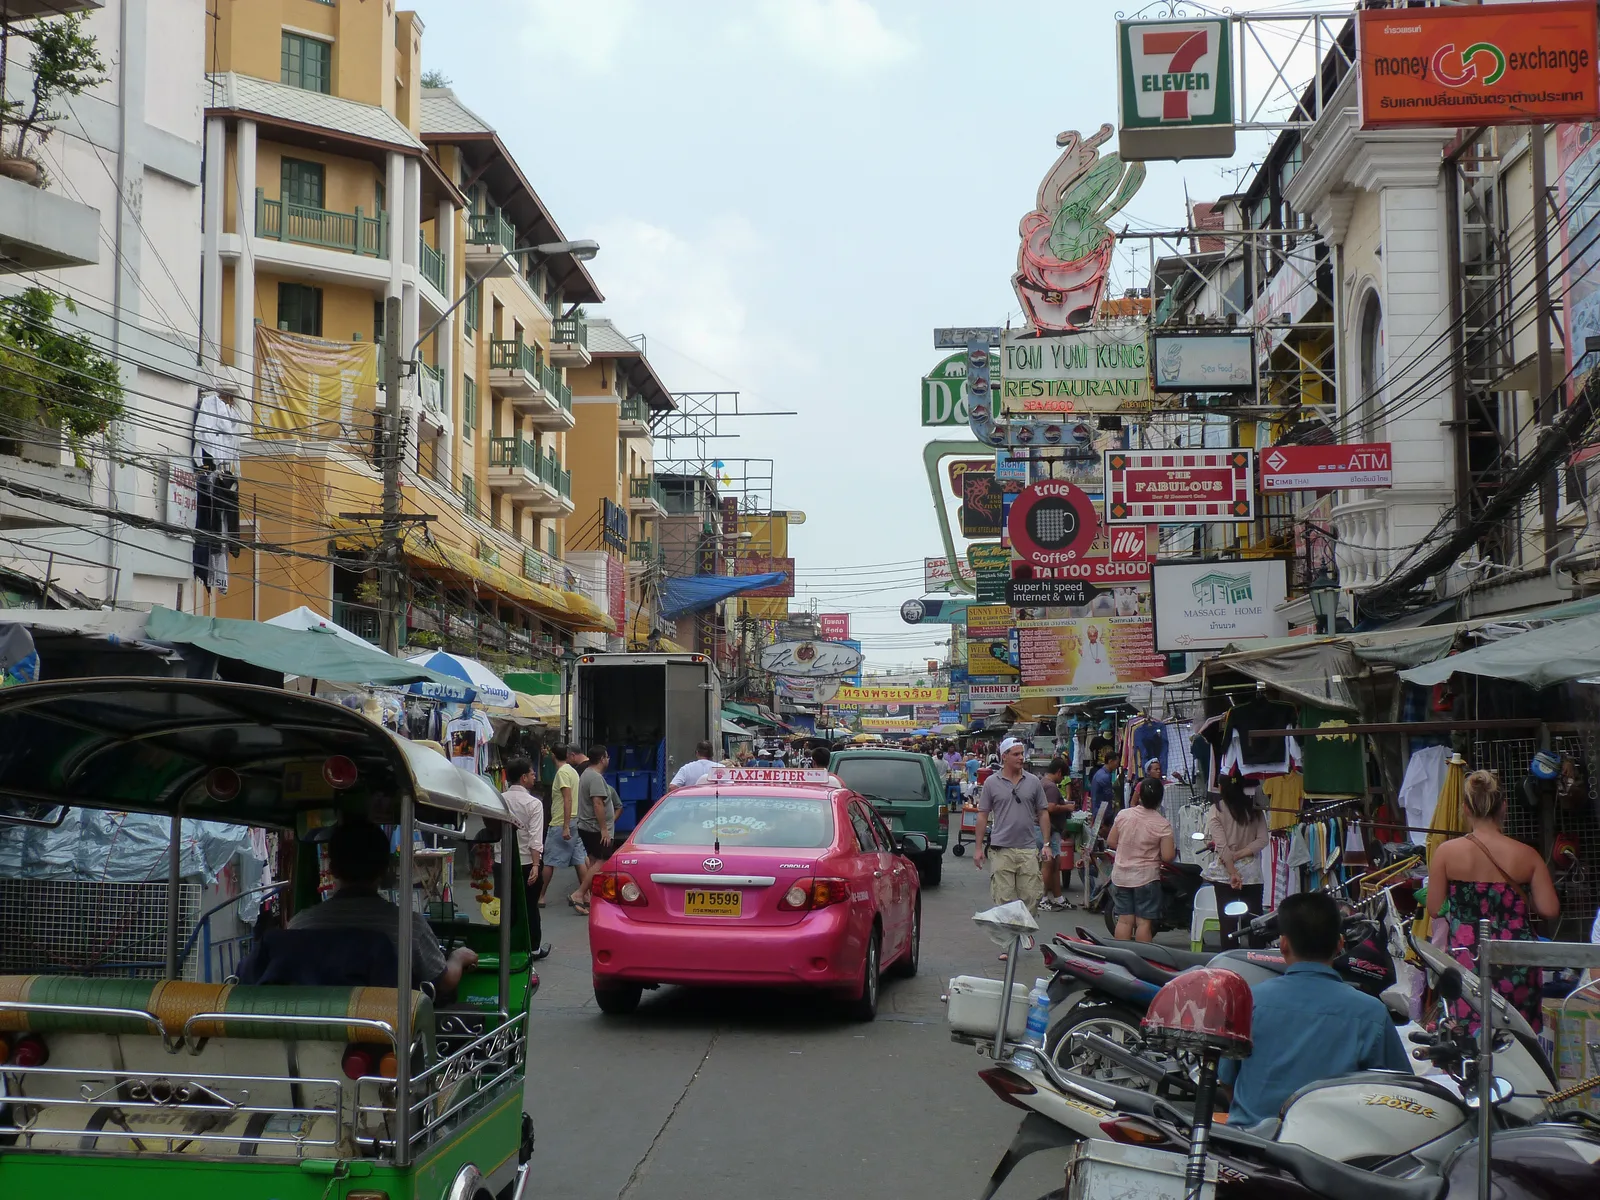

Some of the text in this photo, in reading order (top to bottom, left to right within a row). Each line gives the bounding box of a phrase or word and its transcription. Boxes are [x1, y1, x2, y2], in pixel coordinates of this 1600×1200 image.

[1374, 45, 1590, 80] money exchange
[1142, 30, 1208, 119] 7
[1005, 343, 1145, 370] TOM YUM KUNG
[1200, 364, 1215, 373] Sea
[1004, 379, 1144, 398] RESTAURANT
[1347, 453, 1388, 470] ATM
[1166, 471, 1191, 480] THE
[1034, 484, 1070, 497] true
[1135, 481, 1223, 493] FABULOUS
[1113, 531, 1144, 559] illy
[1032, 549, 1077, 564] coffee
[1013, 583, 1040, 592] super
[1041, 582, 1051, 591] hi
[1054, 582, 1083, 592] speed
[1013, 592, 1085, 601] internet & wi fi
[968, 607, 993, 615] SUNNY
[1184, 607, 1263, 618] MASSAGE HOME
[765, 648, 856, 670] The Club
[843, 688, 932, 699] ทรงพระเจริญ
[971, 685, 1009, 693] INTERNET
[729, 770, 806, 781] TAXI-METER
[687, 892, 740, 906] ทว 5599
[1366, 1095, 1434, 1119] BOXER
